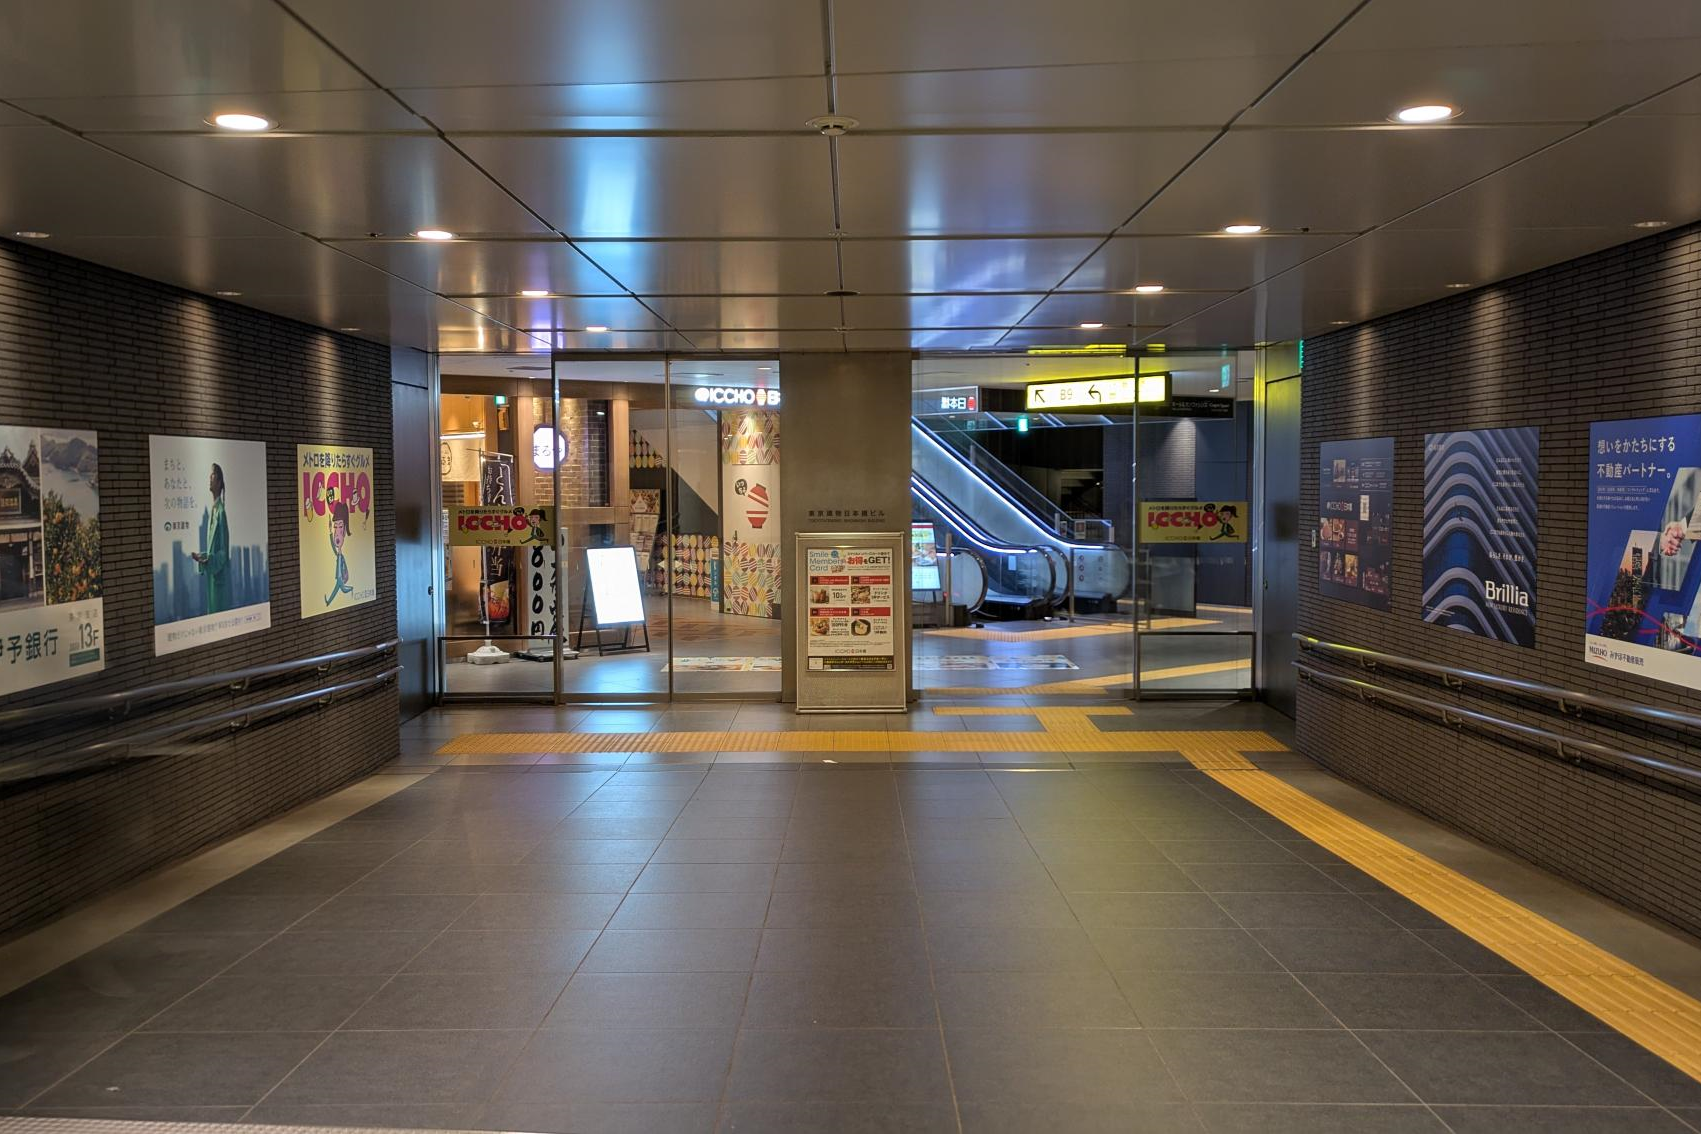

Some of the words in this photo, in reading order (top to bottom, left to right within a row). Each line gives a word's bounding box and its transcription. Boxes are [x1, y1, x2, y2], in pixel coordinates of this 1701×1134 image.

[709, 387, 755, 405] ICCHO
[1597, 436, 1676, 455] 想いをかたちにする
[303, 452, 370, 468] メトロを降りたらすぐグルメ
[1596, 462, 1672, 480] 不動産パートナー。
[302, 471, 371, 518] ICCHO
[457, 515, 528, 532] ICCHO
[1147, 511, 1218, 528] ICCHO
[1485, 581, 1529, 607] Brillia
[79, 622, 99, 649] 13F
